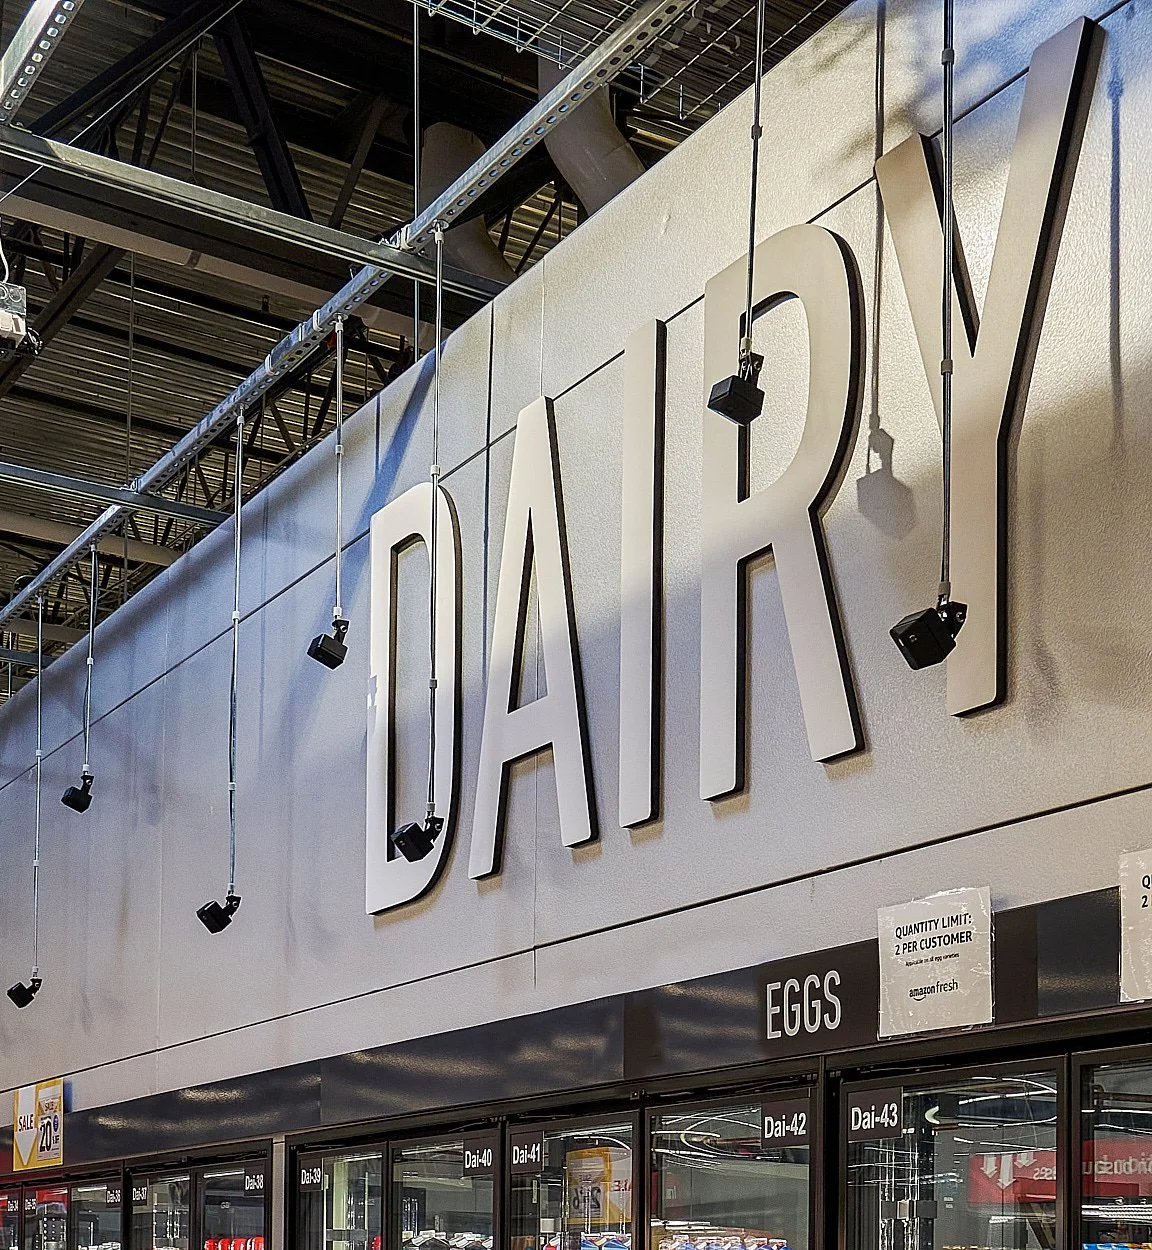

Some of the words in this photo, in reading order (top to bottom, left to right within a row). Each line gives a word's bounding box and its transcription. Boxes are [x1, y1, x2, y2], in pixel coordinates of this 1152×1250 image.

[364, 16, 1105, 916] DAIRY
[895, 918, 940, 939] QUANTITY
[941, 912, 972, 929] LIMIT:
[894, 944, 901, 956] 2
[902, 940, 918, 954] PER
[919, 930, 973, 951] CUSTOMER
[766, 969, 842, 1040] EGGS
[18, 1113, 34, 1132] SALE
[764, 1112, 807, 1140] Dai-42
[850, 1103, 899, 1130] Dai-43
[464, 1148, 492, 1168] Dai-40
[512, 1143, 541, 1164] Dai-41
[244, 1174, 264, 1191] Dai-38
[301, 1167, 321, 1185] Dai-39
